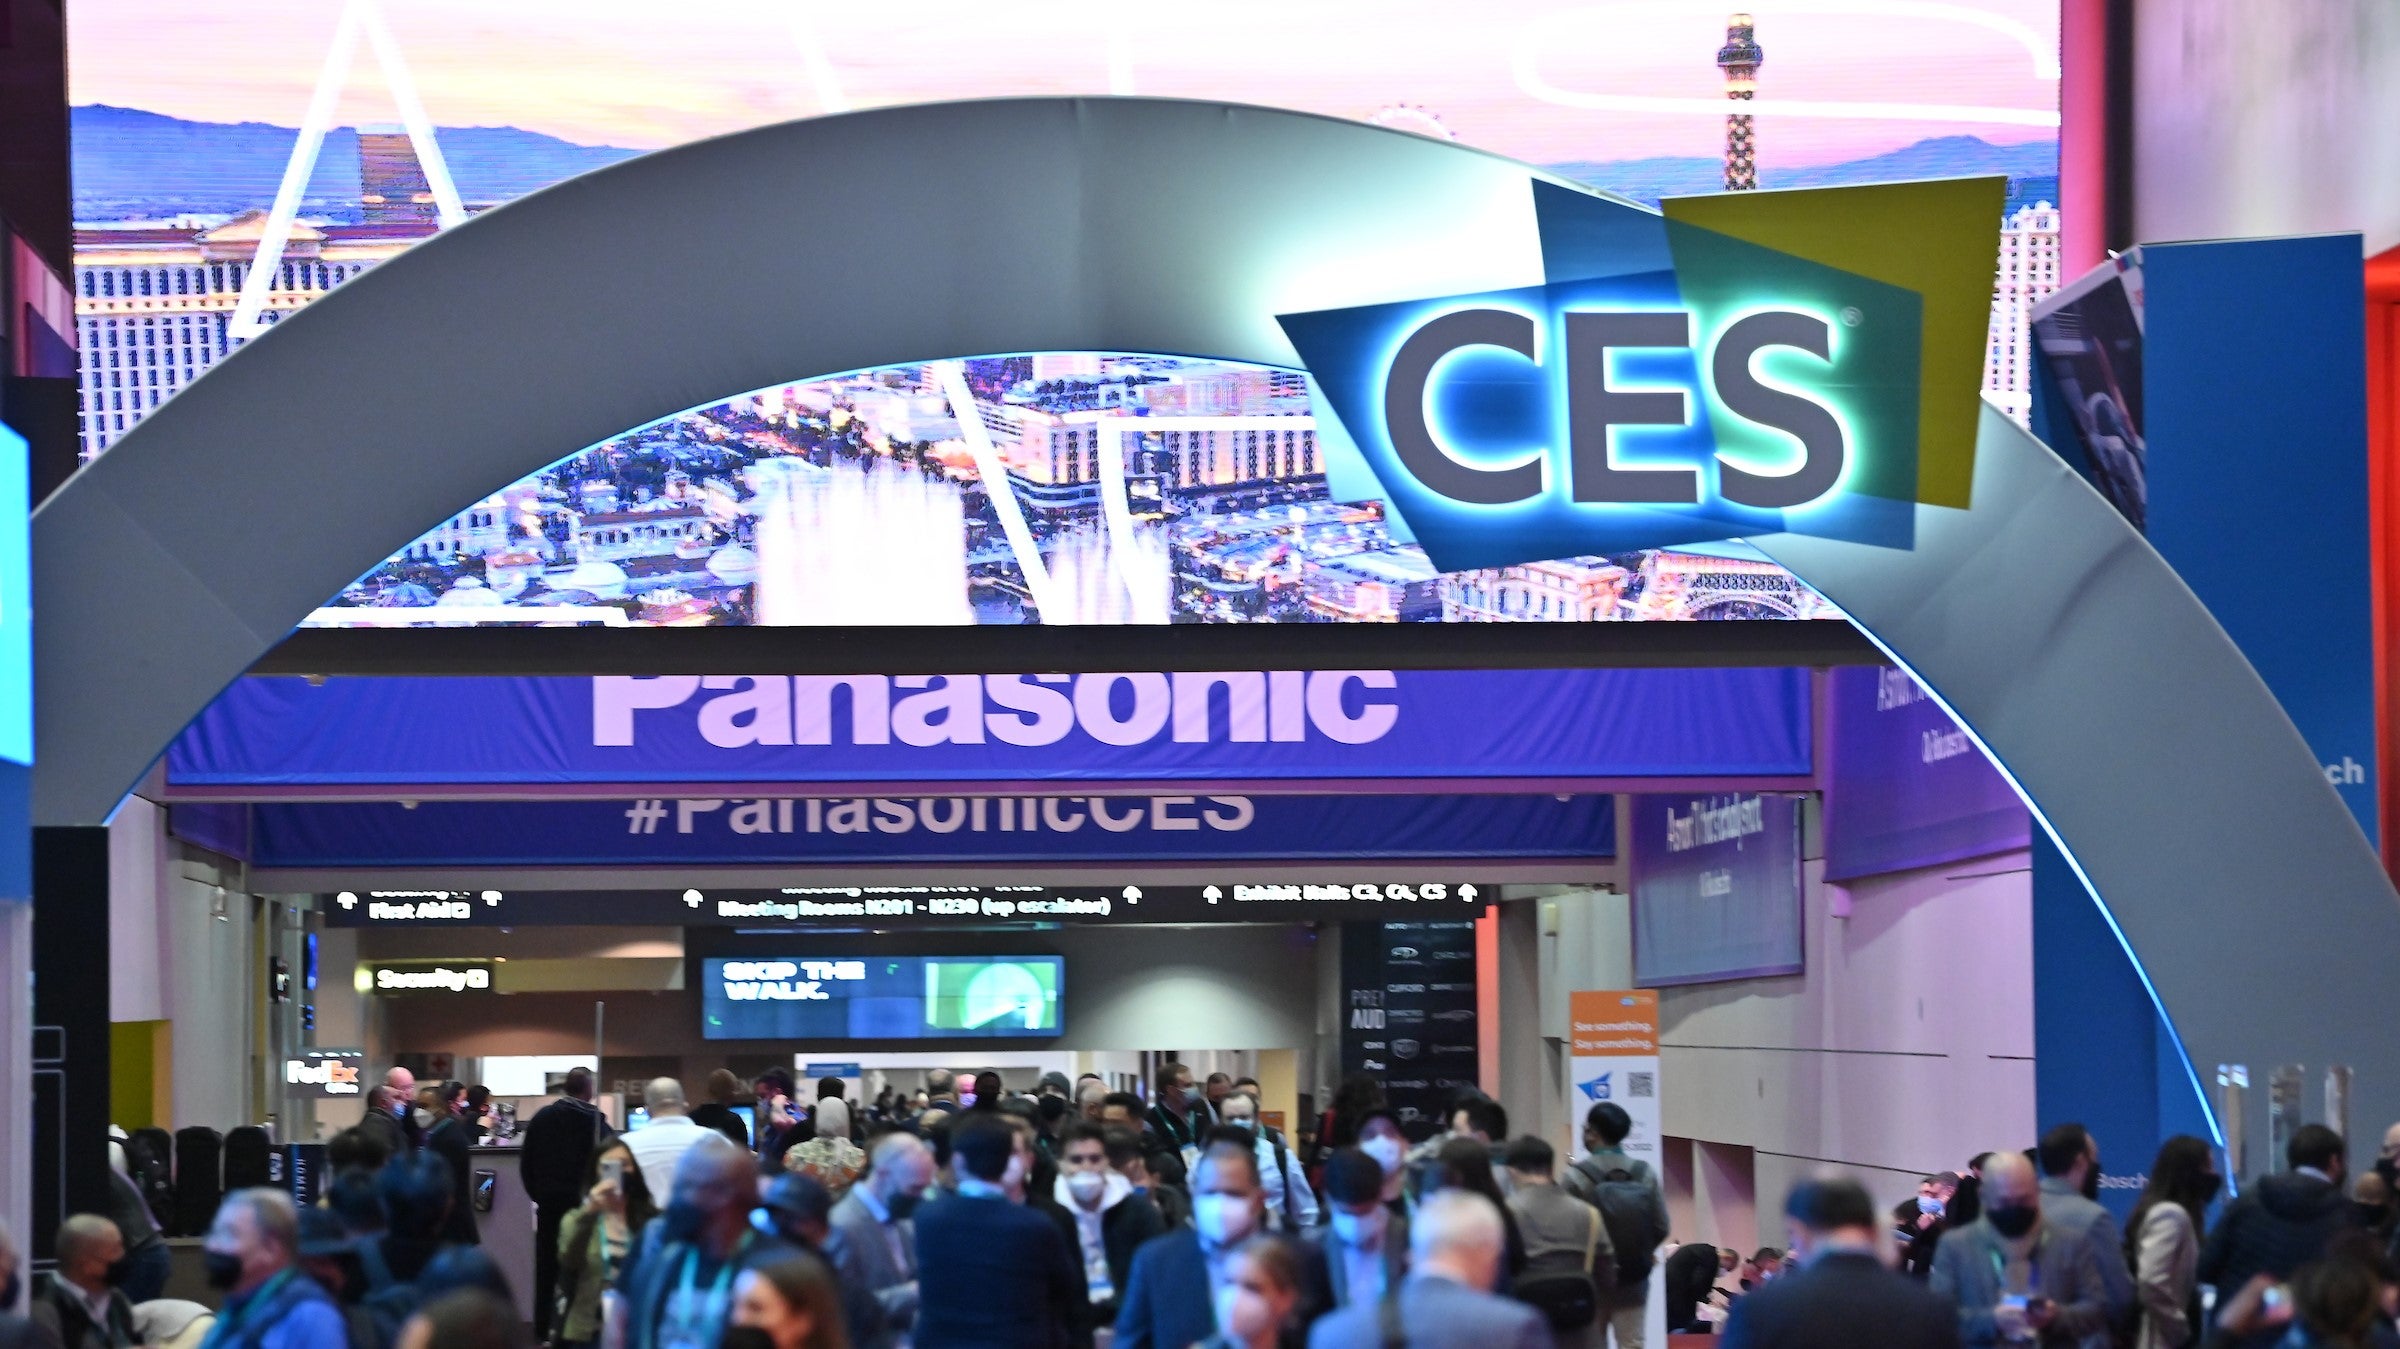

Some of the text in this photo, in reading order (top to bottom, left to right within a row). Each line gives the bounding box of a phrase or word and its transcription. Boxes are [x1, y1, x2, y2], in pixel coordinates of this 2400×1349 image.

[1384, 308, 1845, 508] CES
[1234, 885, 1301, 900] Exhibit
[1303, 884, 1350, 900] Halls
[1419, 884, 1447, 900] C5
[369, 902, 450, 919] First Aid
[718, 900, 798, 920] Meeting
[799, 900, 864, 916] Rooms
[1017, 896, 1111, 915] escalator)
[377, 968, 466, 992] Security
[722, 961, 866, 981] SKIP THE
[723, 981, 829, 1001] WALK.
[1574, 1021, 1592, 1032] See
[287, 1060, 359, 1084] FedEx
